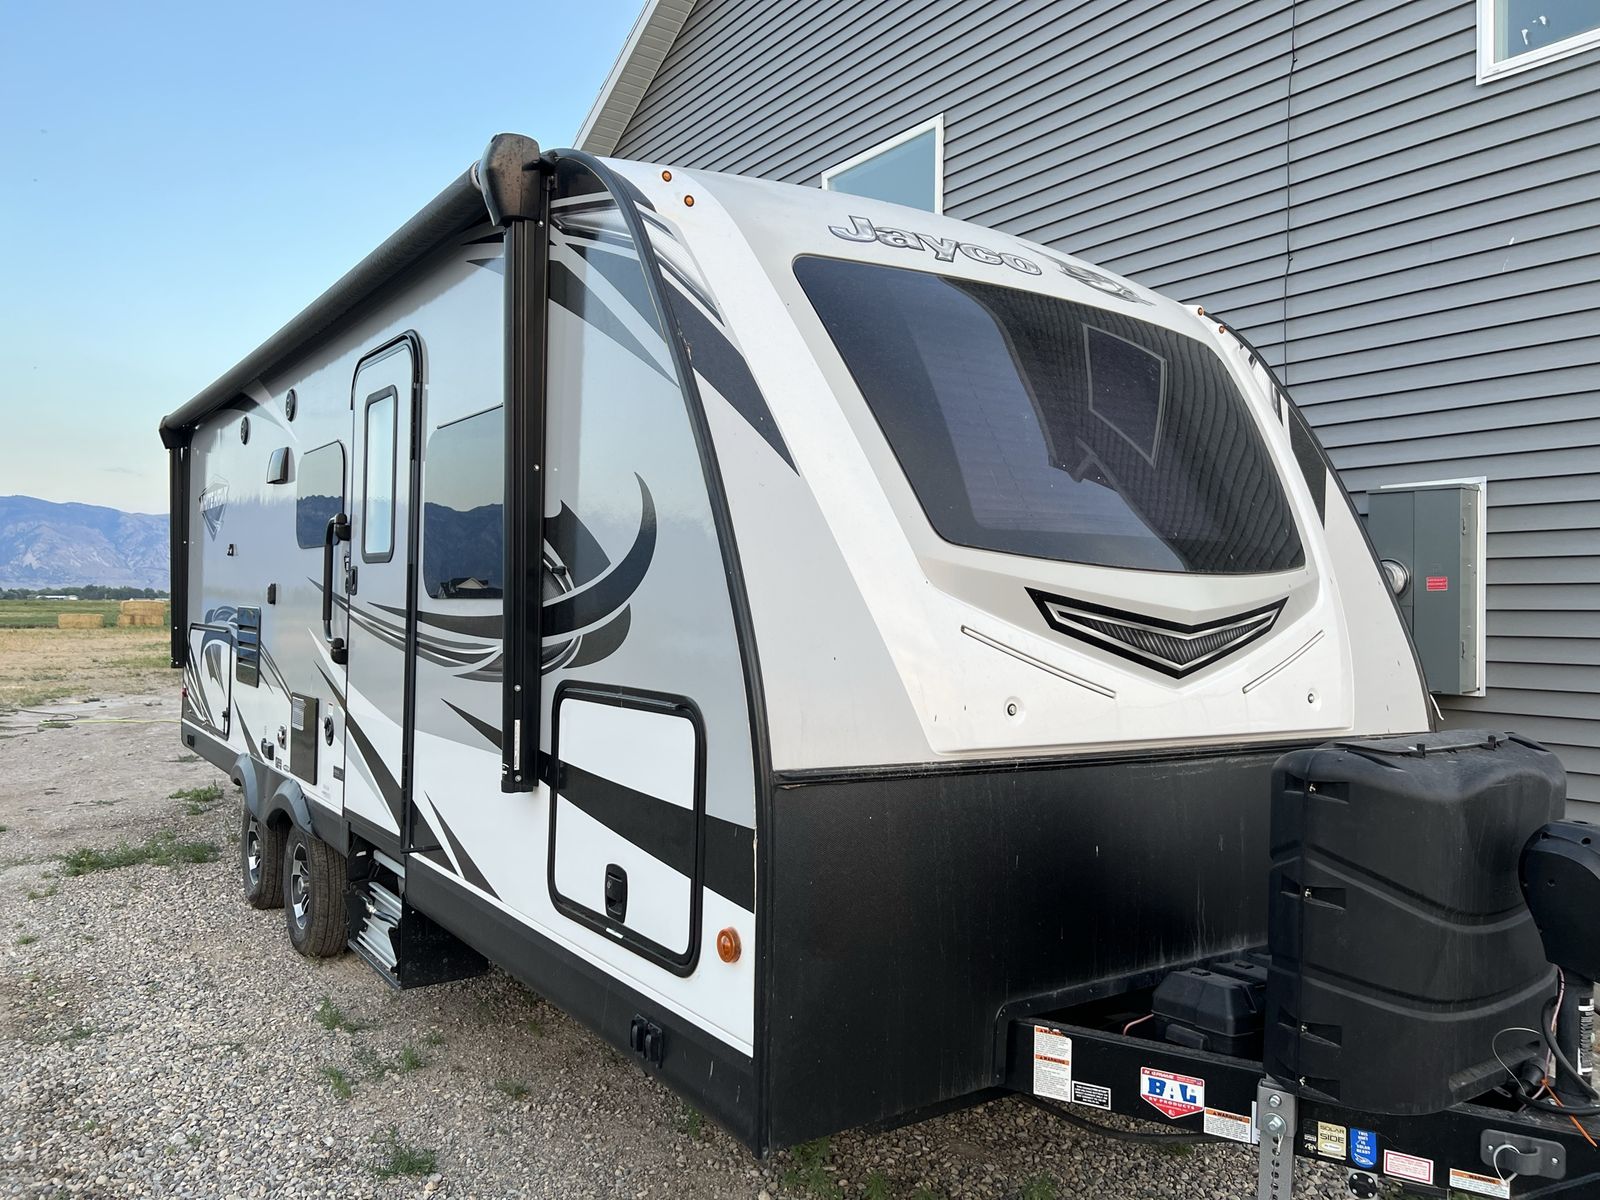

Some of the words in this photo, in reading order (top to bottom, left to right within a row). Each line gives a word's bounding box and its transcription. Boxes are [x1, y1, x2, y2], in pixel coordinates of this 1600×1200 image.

[828, 215, 1042, 276] Jayco
[1148, 1077, 1197, 1104] BAL
[1159, 1098, 1195, 1110] PRODUCTS
[1217, 1111, 1243, 1121] WARNING
[1320, 1125, 1344, 1134] SOLAR
[1320, 1133, 1344, 1144] SIDE
